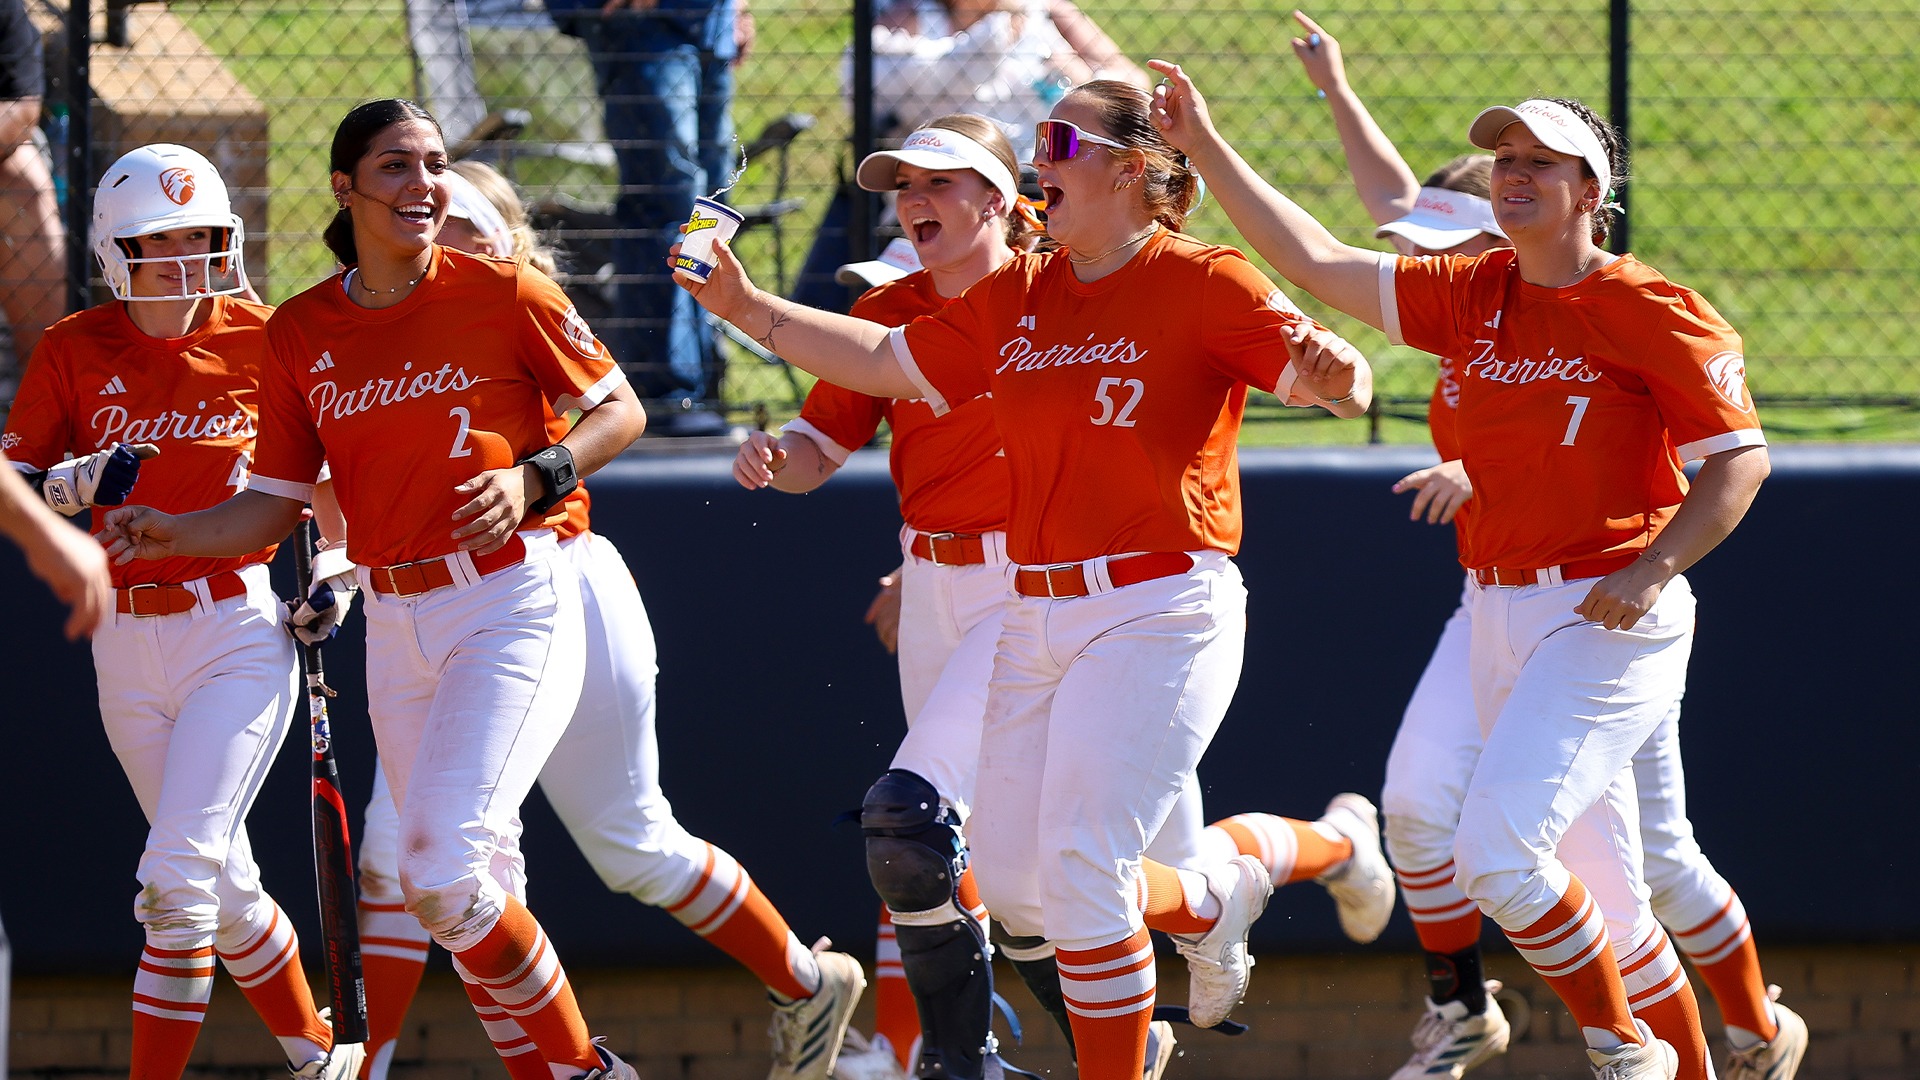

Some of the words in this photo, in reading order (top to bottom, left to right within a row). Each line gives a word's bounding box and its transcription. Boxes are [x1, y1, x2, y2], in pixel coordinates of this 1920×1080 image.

[996, 332, 1149, 375] Patriots
[1463, 339, 1602, 384] Patriots
[309, 361, 491, 428] Patriots
[1090, 376, 1145, 427] 52
[91, 400, 258, 448] Patriots
[447, 405, 472, 459] 2
